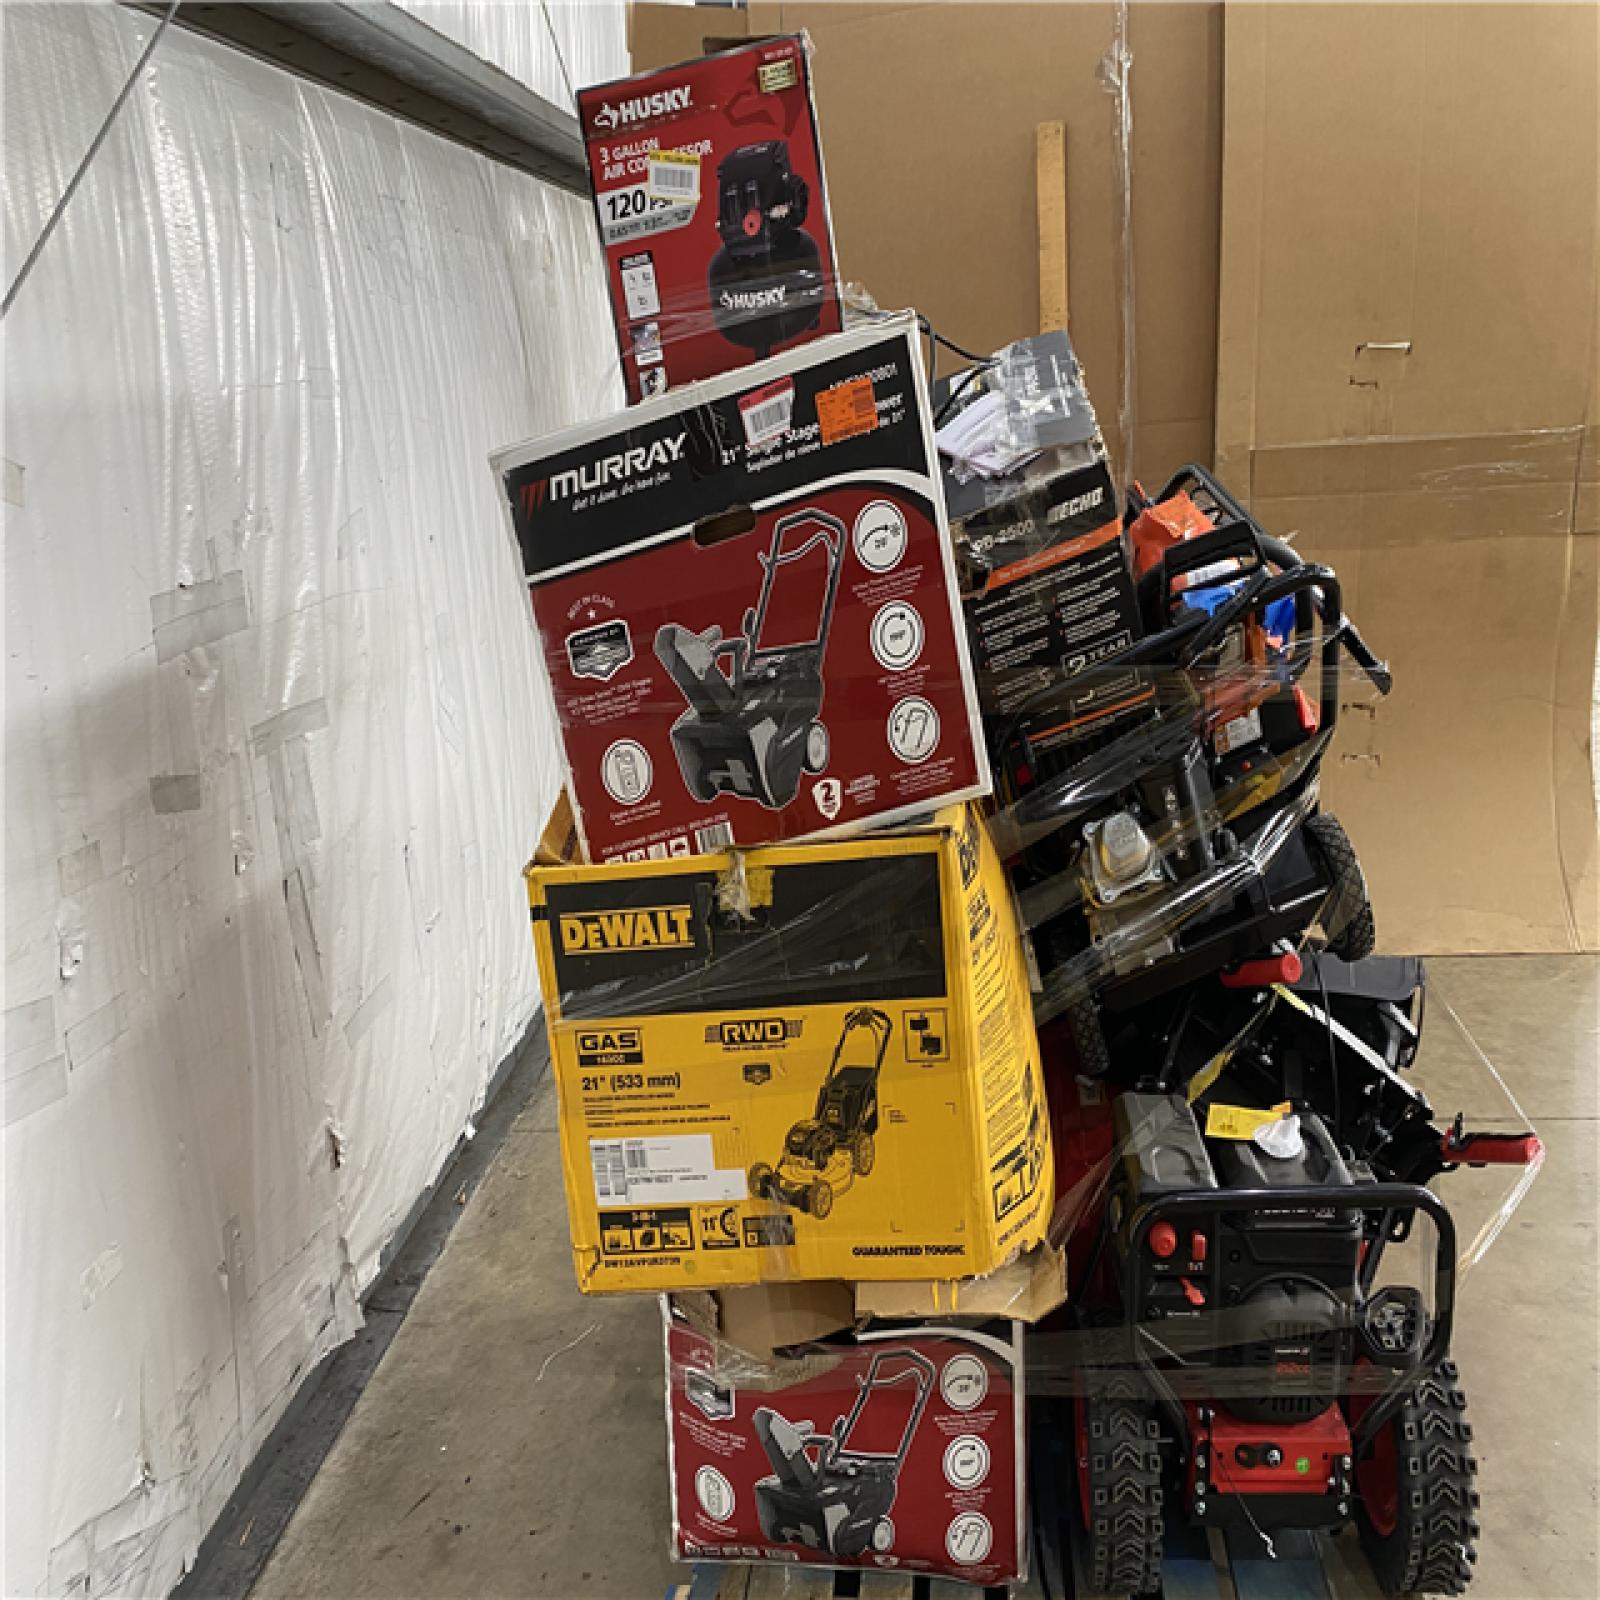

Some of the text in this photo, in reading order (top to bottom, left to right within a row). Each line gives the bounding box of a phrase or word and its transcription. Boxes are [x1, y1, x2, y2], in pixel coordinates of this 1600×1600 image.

[621, 86, 691, 123] HUSKY
[599, 138, 659, 162] 3 GALLON
[604, 162, 626, 181] AIR
[607, 190, 645, 221] 120
[733, 286, 785, 310] HUSKY
[549, 431, 686, 501] MURRAY
[1058, 487, 1104, 517] ECHO
[580, 1032, 637, 1051] GAS
[723, 1023, 784, 1043] RWD
[852, 1245, 923, 1257] GUARANTEED
